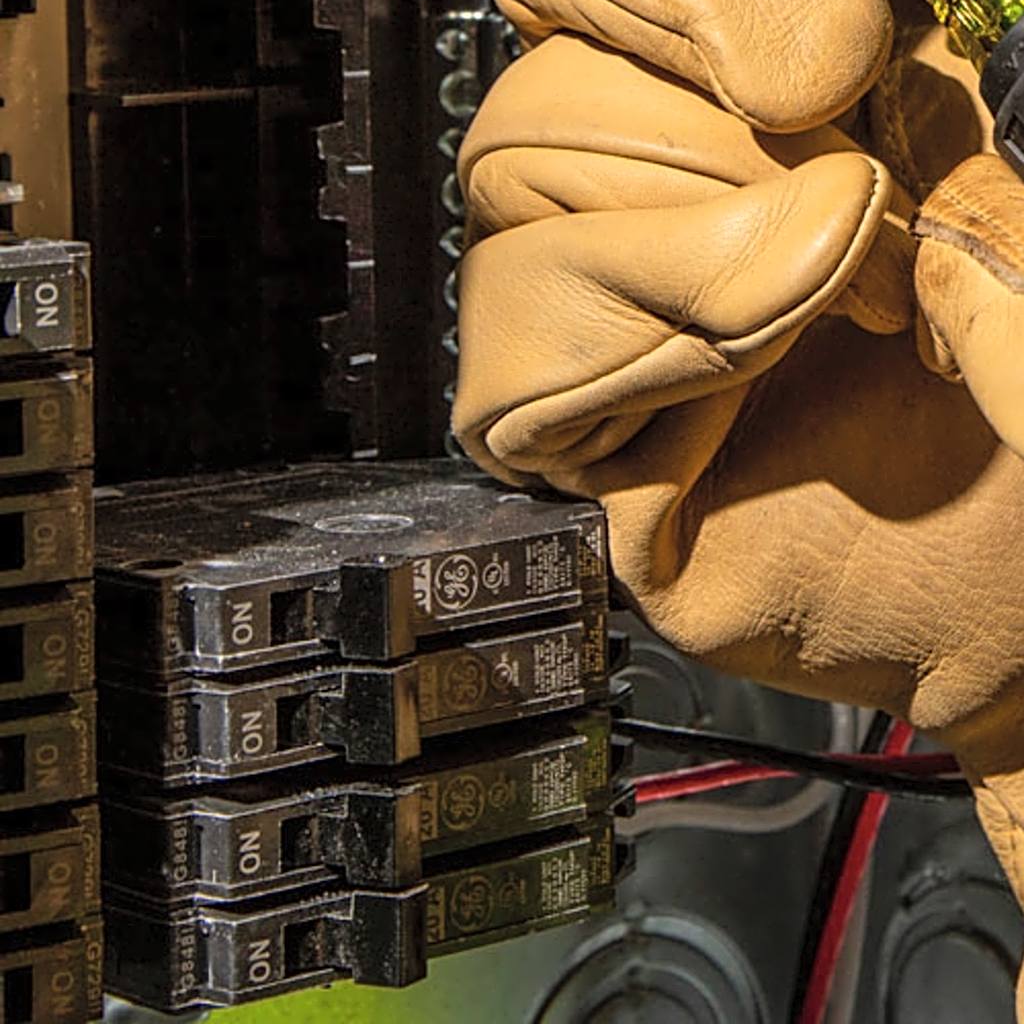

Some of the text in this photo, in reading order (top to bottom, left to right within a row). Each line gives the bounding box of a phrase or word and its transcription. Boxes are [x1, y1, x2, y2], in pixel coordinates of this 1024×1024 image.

[35, 282, 59, 327] ON
[33, 523, 56, 566] ON
[231, 601, 253, 645] ON
[42, 633, 67, 679] ON
[241, 710, 263, 755] ON
[35, 744, 60, 788] ON
[239, 830, 261, 875] ON
[249, 939, 271, 983] ON
[52, 972, 74, 1014] ON
